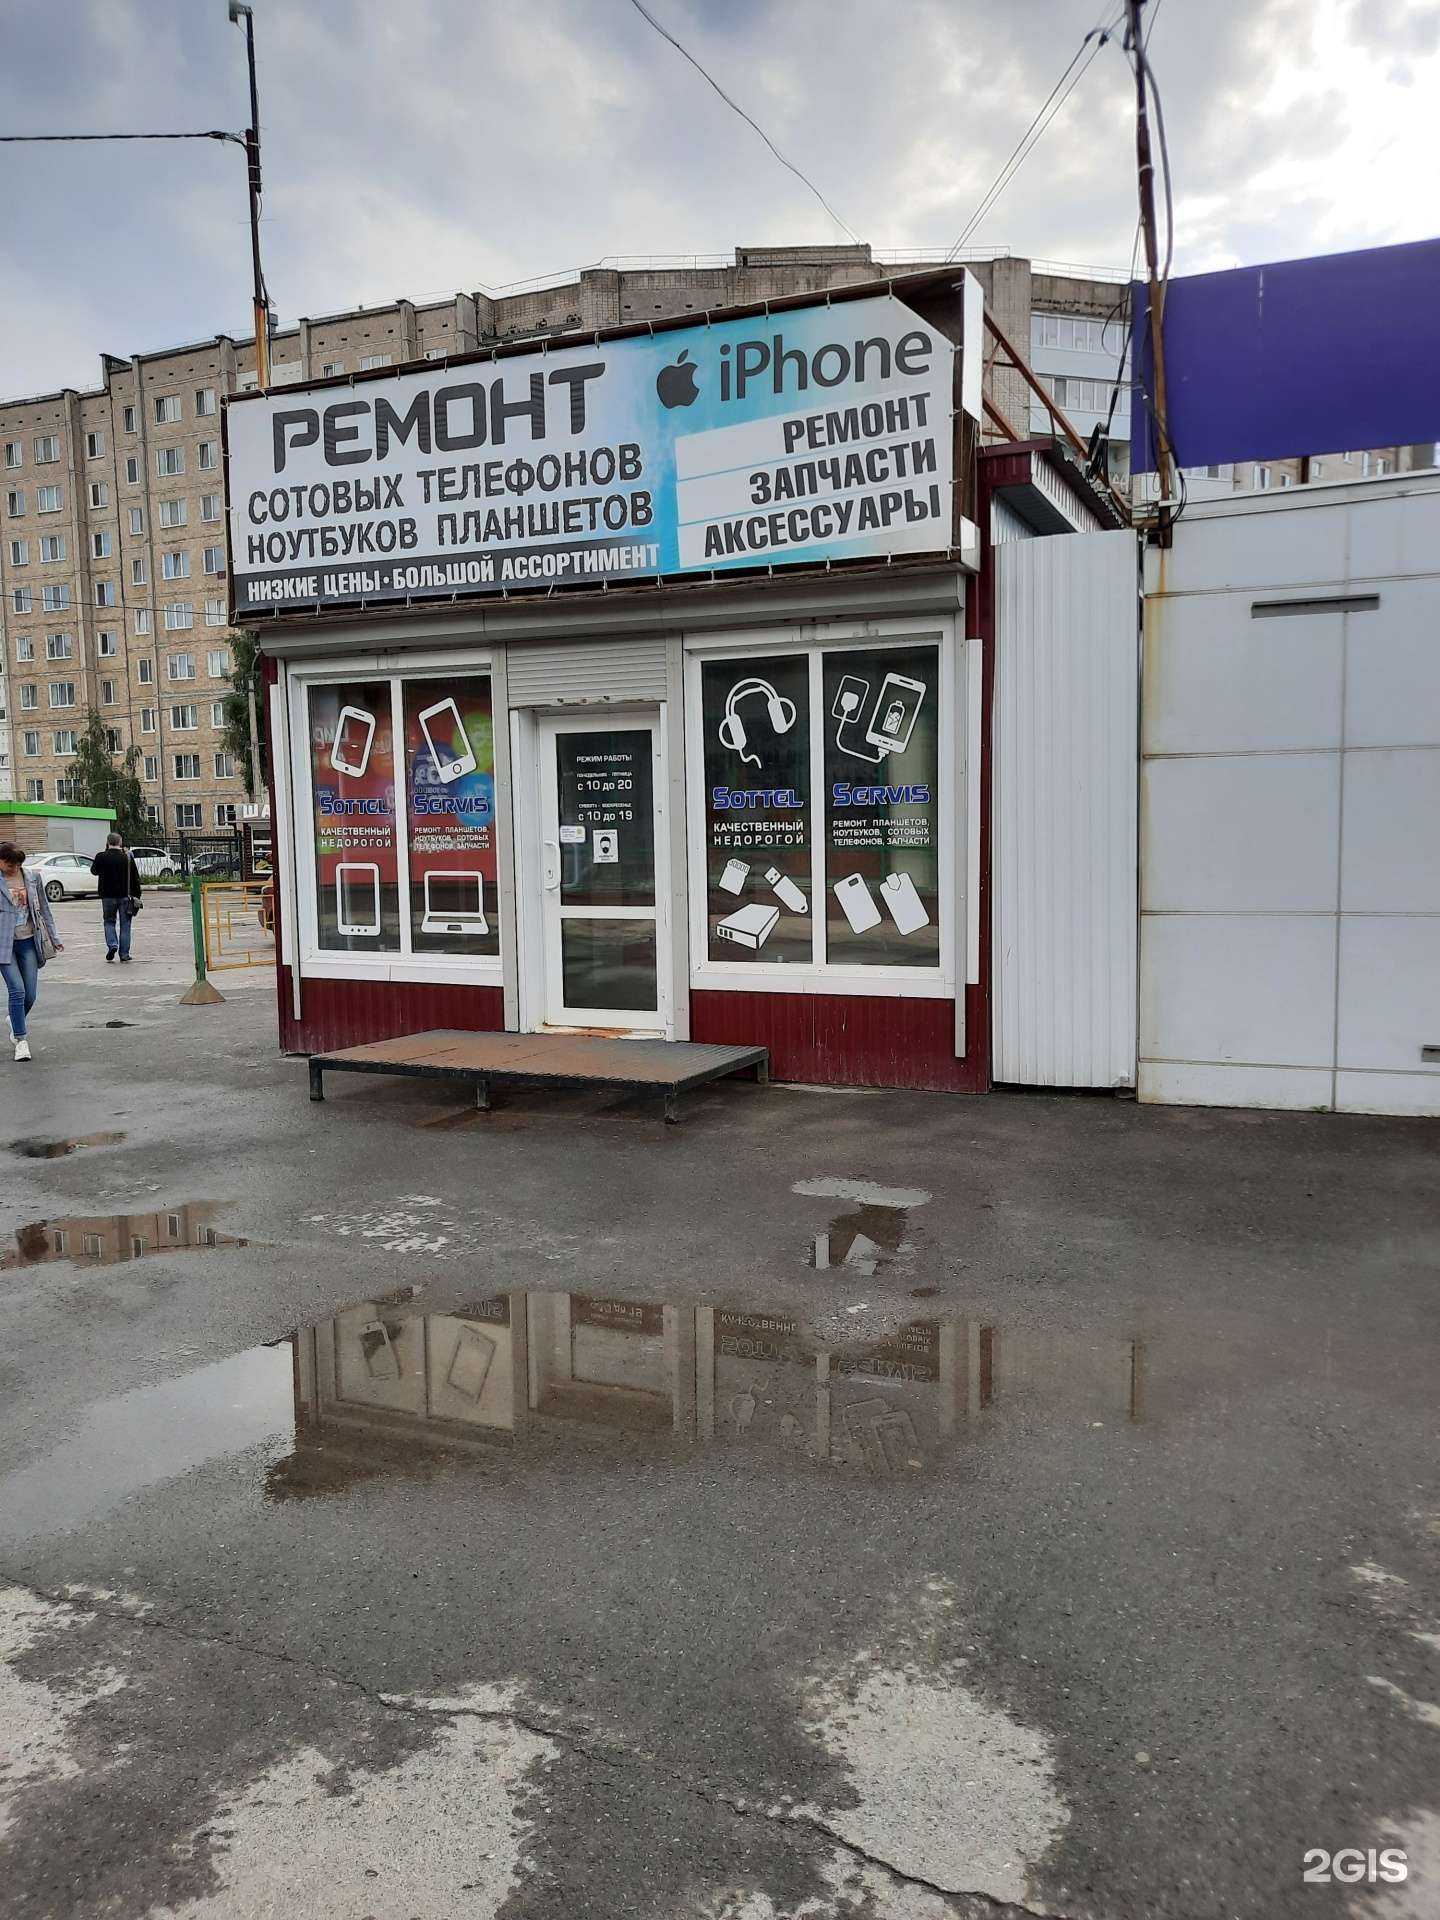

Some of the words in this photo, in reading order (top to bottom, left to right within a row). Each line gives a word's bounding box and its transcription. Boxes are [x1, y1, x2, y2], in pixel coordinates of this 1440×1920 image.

[720, 330, 933, 402] iPhone
[272, 362, 606, 473] РЕМОНТ
[783, 392, 931, 454] РЕМОНТ
[749, 438, 937, 505] ЗАПЧАСТИ
[248, 473, 405, 525] СОТОВЫХ
[417, 443, 643, 503] ТЕЛЕФОНОВ
[248, 517, 418, 564] НОУТБУКОВ
[437, 490, 654, 546] ПЛАНШЕТОВ
[704, 484, 941, 557] АКСЕССУАРЫ
[247, 577, 319, 602] НИЗКИЕ
[324, 570, 381, 596] ЦЕНЫ
[393, 554, 495, 589] БОЛЬШОЙ
[501, 543, 660, 580] АССОРТИМЕНТ
[586, 780, 600, 790] 10
[602, 782, 615, 791] до
[617, 779, 632, 790] 20
[832, 782, 930, 807] SERVIS
[320, 796, 391, 815] SOTTEL
[413, 794, 489, 815] SERVIS
[713, 786, 804, 810] SOTTEL
[586, 810, 600, 821] 10
[603, 813, 615, 822] до
[618, 810, 632, 821] 19
[713, 819, 804, 833] КАЧЕСТВЕННЫЙ
[832, 819, 867, 828] РЕМОНТ
[872, 818, 930, 828] ПЛАНШЕТОВ,
[321, 824, 391, 836] КАЧЕСТВЕННЫЙ
[414, 826, 441, 834] РЕМОНТ
[833, 828, 882, 837] НОУТБУКОВ,
[887, 828, 929, 836] СОТОВЫХ
[321, 837, 392, 848] НЕДОРОГОЙ
[714, 834, 804, 847] НЕДОРОГОЙ
[833, 837, 885, 846] ТЕЛЕФОНОВ,
[886, 837, 930, 845] ЗАПЧАСТИ
